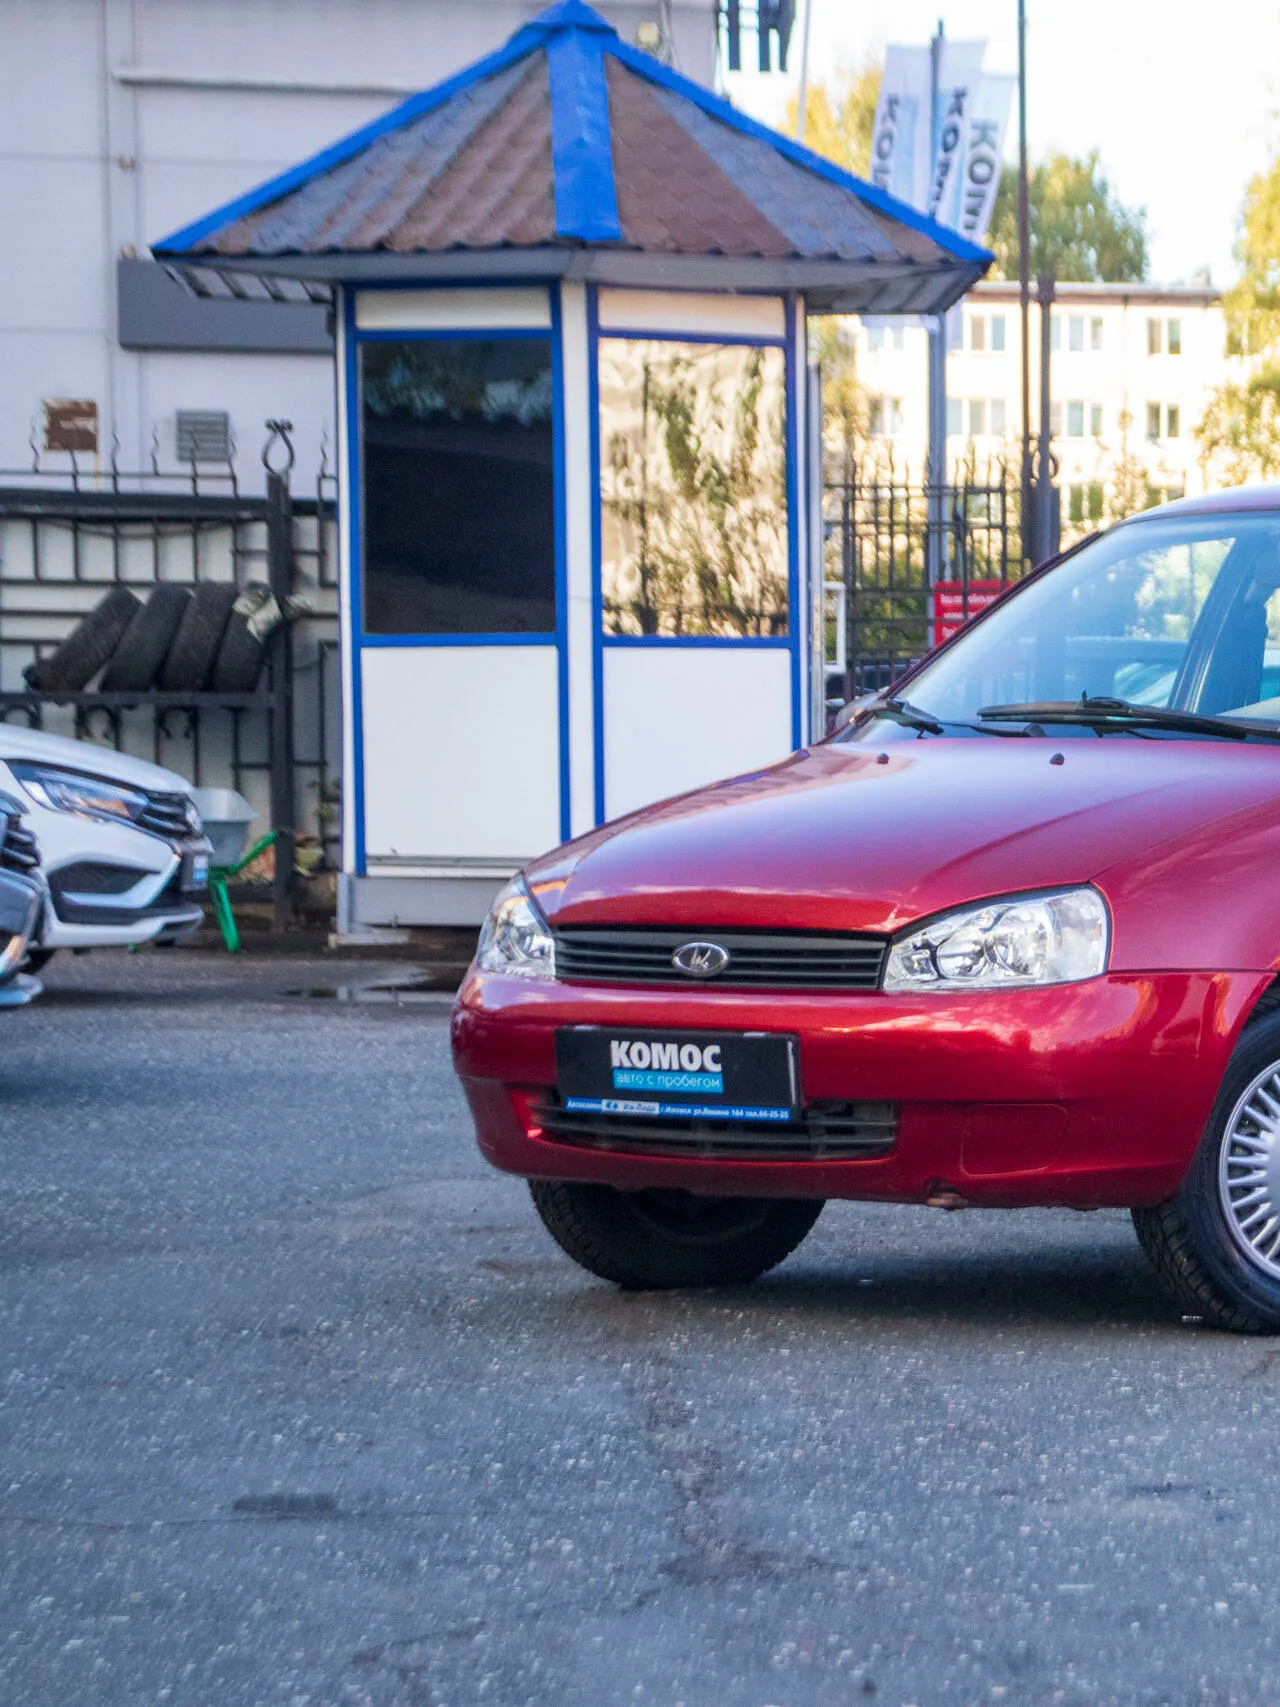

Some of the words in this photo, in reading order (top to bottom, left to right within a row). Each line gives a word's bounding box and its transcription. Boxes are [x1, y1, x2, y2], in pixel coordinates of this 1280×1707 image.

[931, 86, 968, 208] КОМ
[964, 119, 999, 230] КОМ
[611, 1040, 722, 1072] КОМОС
[617, 1073, 643, 1083] авто
[647, 1075, 653, 1084] с
[657, 1074, 720, 1088] пробегом
